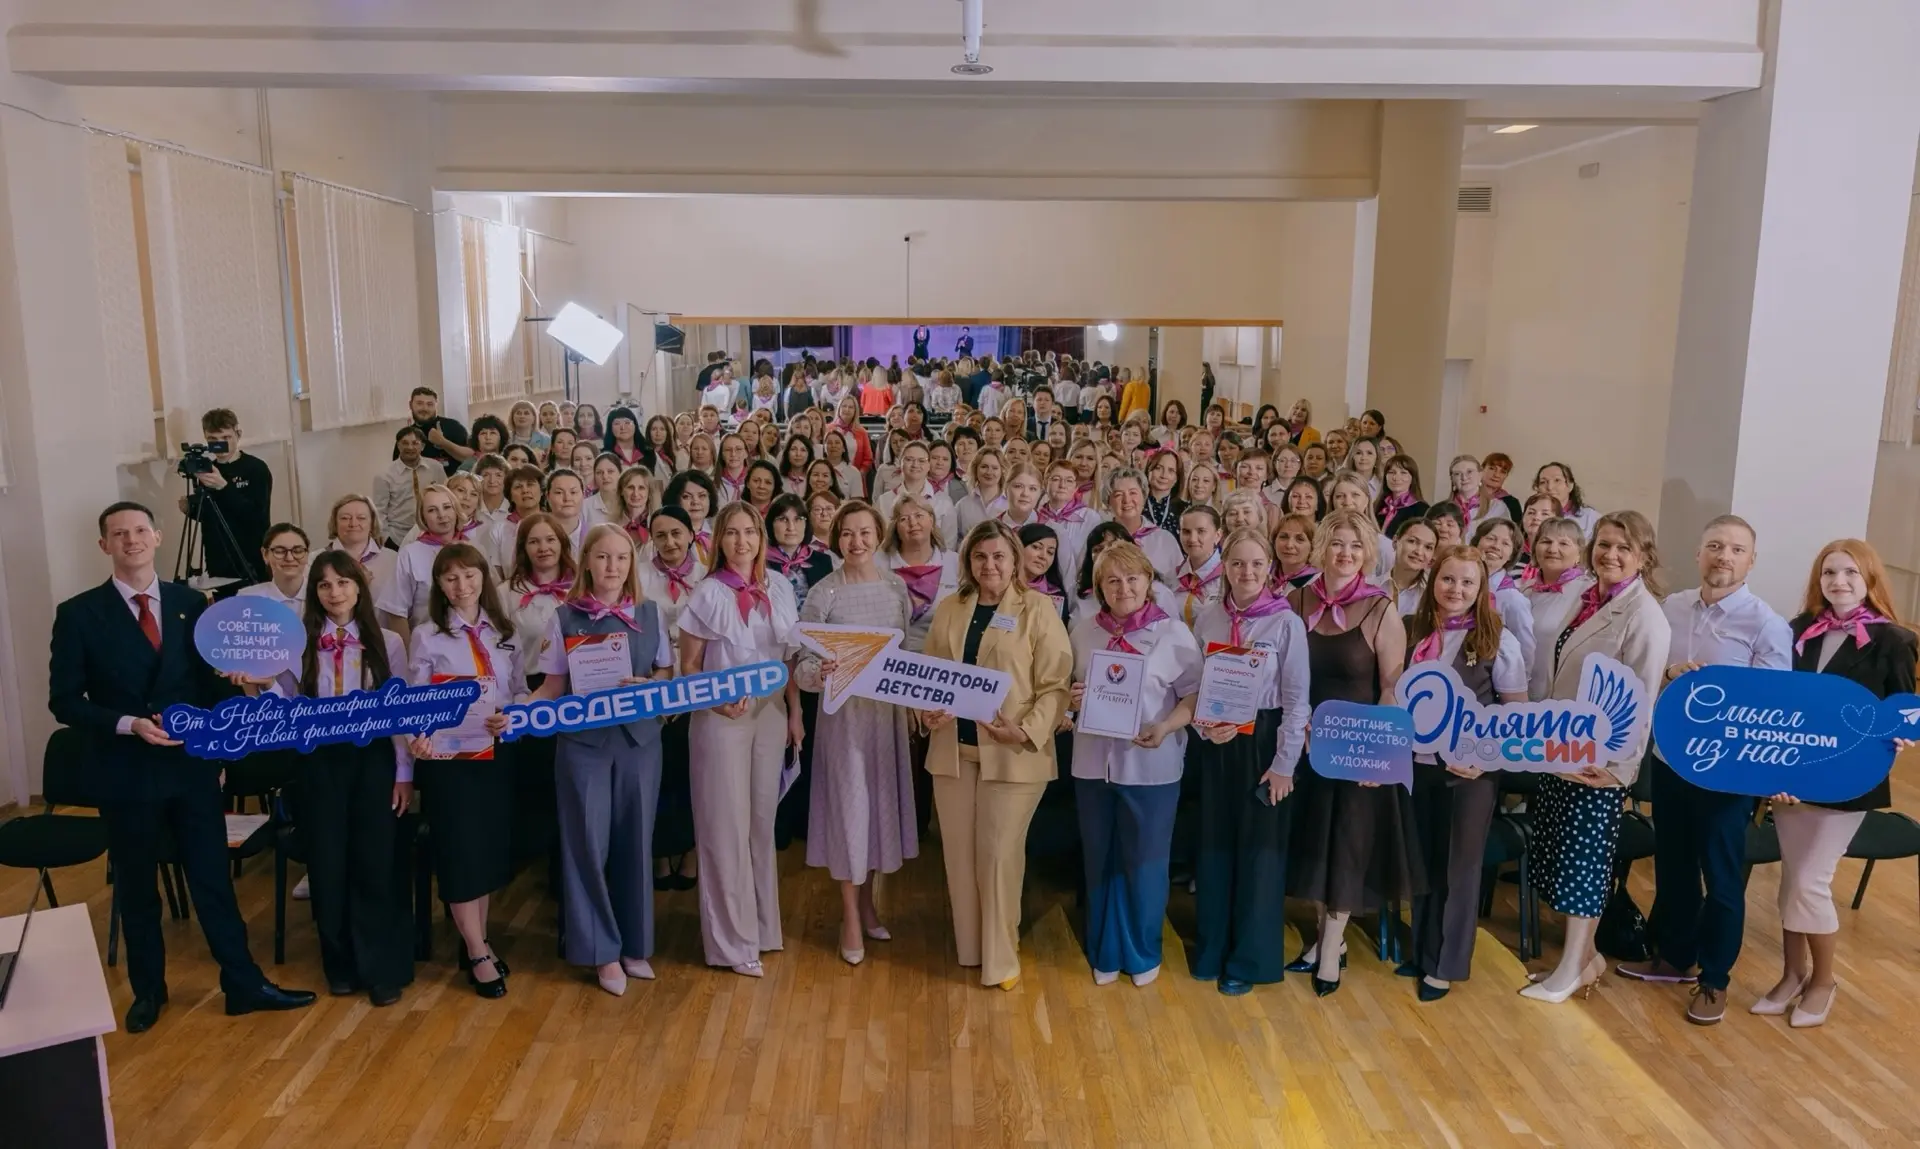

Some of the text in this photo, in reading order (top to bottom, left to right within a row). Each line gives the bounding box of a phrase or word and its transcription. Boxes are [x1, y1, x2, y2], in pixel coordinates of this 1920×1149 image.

[242, 608, 251, 618] Я
[211, 648, 289, 660] СУПЕРГЕРОЙ
[223, 635, 279, 647] А ЗНАЧИТ
[883, 657, 999, 695] НАВИГАТОРЫ
[506, 665, 783, 735] РОСДЕТЦЕНТР
[876, 678, 955, 706] ДЕТСТВА
[1685, 682, 1804, 728] Смысл
[170, 684, 475, 733] От Новой философии воспитания
[1405, 671, 1597, 752] Орлята
[207, 740, 219, 751] к
[224, 720, 299, 752] Новой
[303, 717, 393, 745] философии
[398, 703, 463, 731] жизни!
[1315, 728, 1339, 739] ЭТО
[1324, 715, 1393, 732] ВОСПИТАНИЕ
[1330, 754, 1391, 771] ХУДОЖНИК
[1348, 744, 1355, 754] А
[1357, 745, 1365, 755] Я
[1455, 737, 1596, 765] РОССИИ
[1685, 737, 1801, 772] из нас
